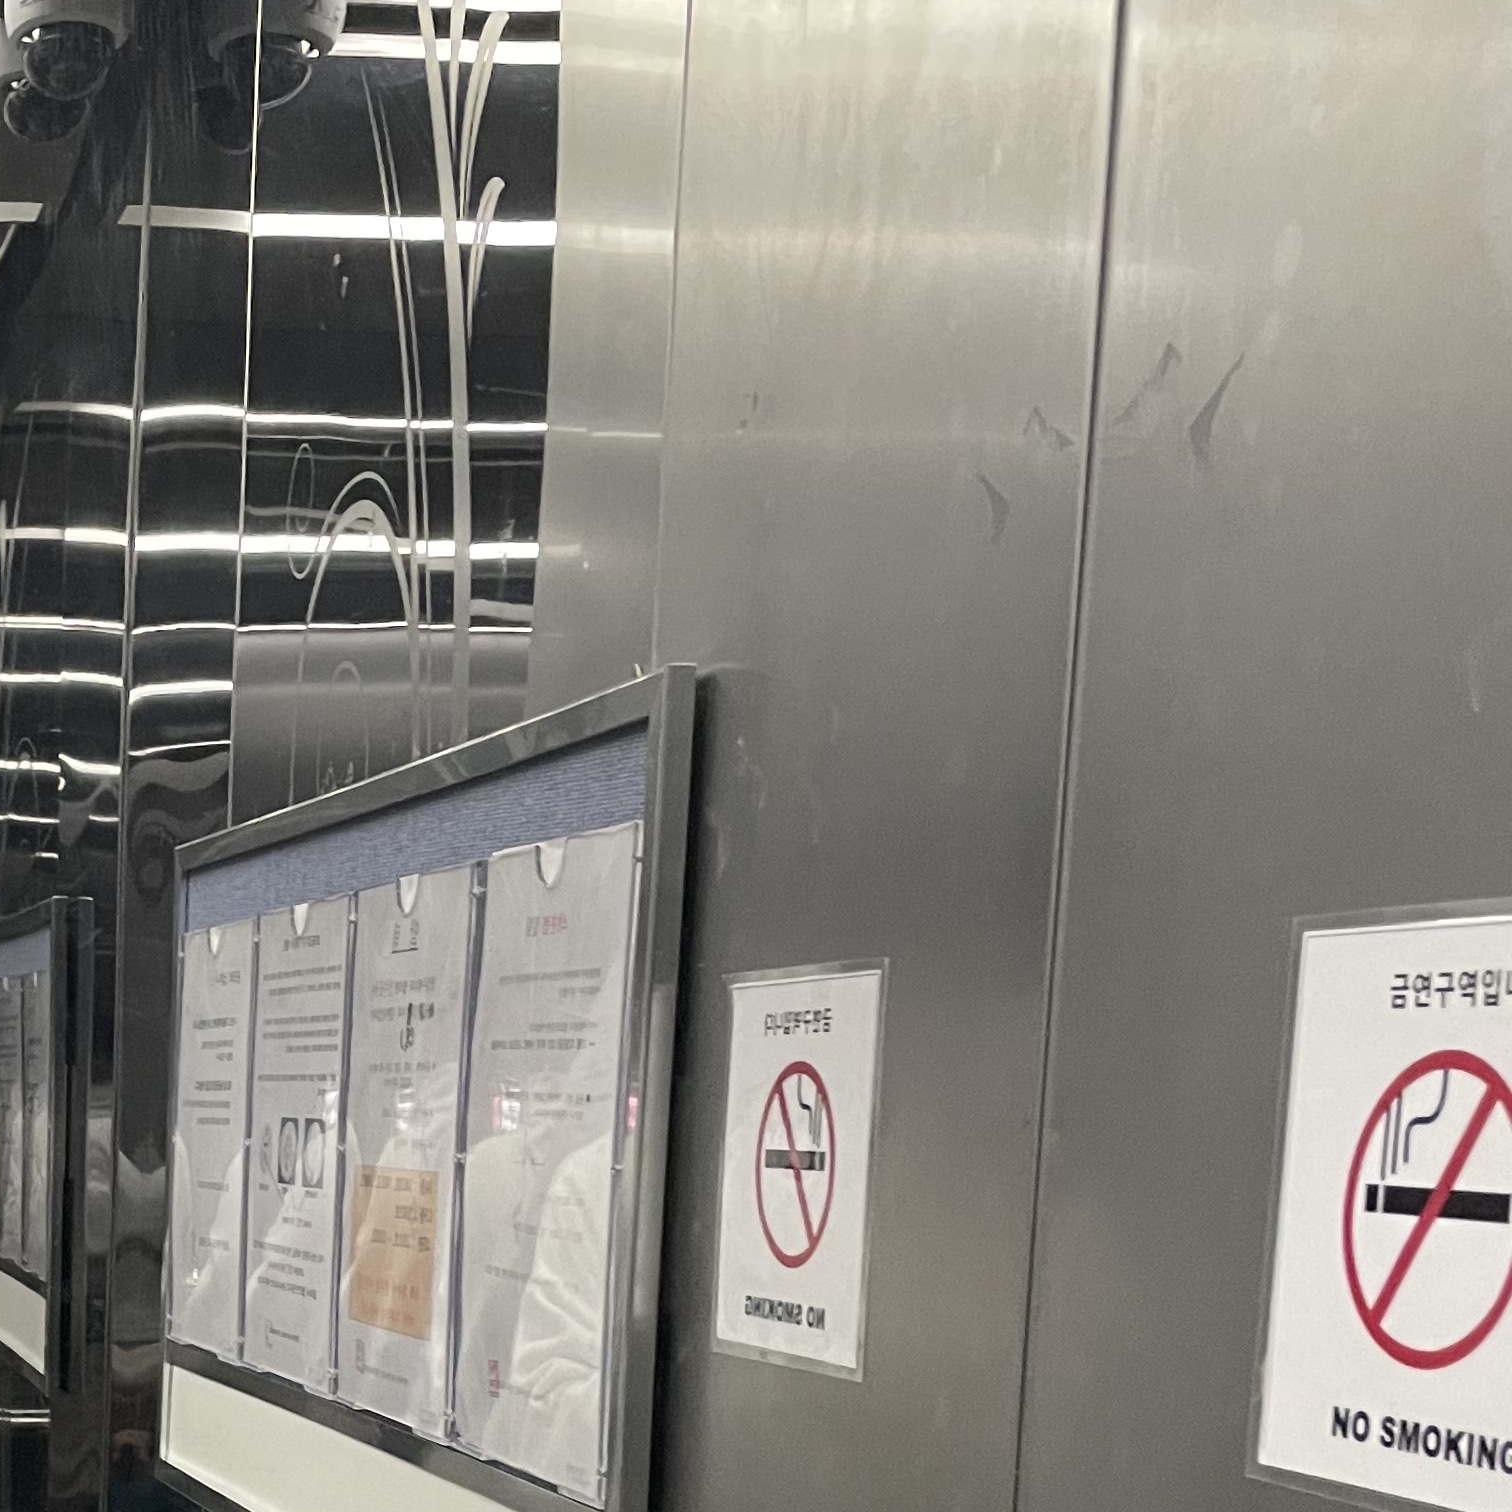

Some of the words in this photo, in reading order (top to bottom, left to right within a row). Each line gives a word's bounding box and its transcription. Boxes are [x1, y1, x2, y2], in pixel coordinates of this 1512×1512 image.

[1388, 969, 1512, 1009] 금연구역입
[1331, 1405, 1370, 1442] NO
[1380, 1416, 1512, 1474] SMOKING
